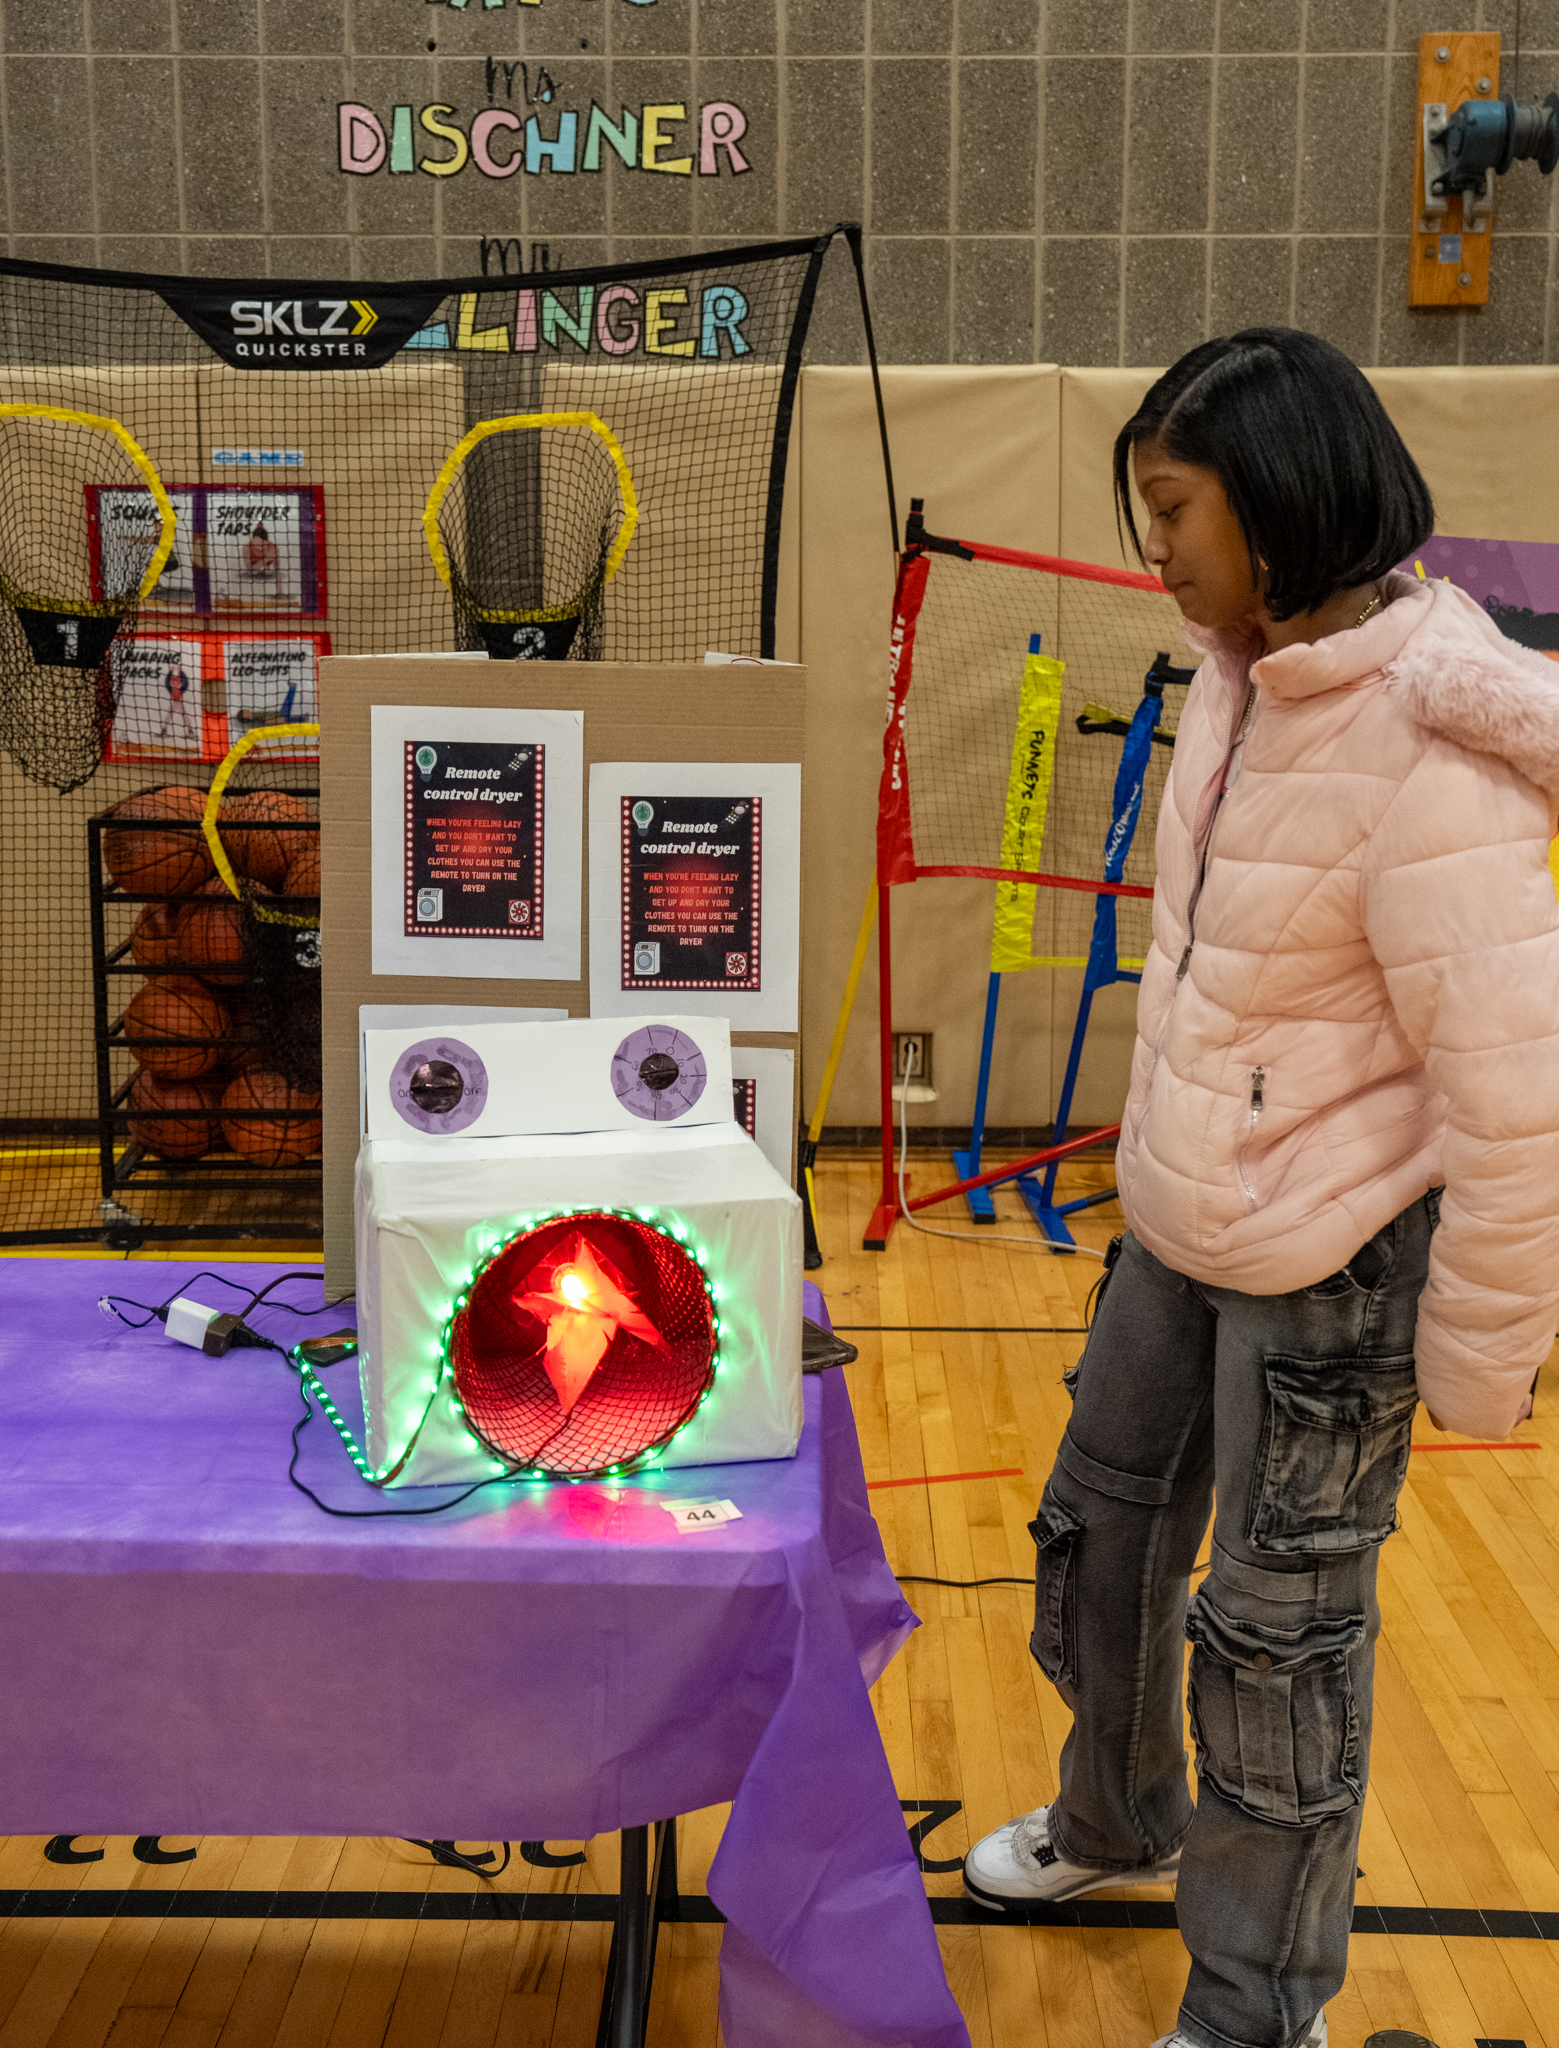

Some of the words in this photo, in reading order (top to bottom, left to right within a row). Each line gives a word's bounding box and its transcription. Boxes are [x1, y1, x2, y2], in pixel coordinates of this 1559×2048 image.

[337, 99, 753, 178] DISCHNER
[230, 300, 349, 336] SKLZ
[236, 343, 367, 357] QUICKSTER
[217, 522, 252, 536] TAPS
[56, 620, 79, 660] 1
[445, 767, 501, 779] Remote
[424, 788, 479, 800] control
[480, 788, 523, 804] dryer
[427, 818, 446, 826] WHEN
[448, 819, 471, 827] YOU'RE
[661, 821, 718, 833] Remote
[449, 832, 461, 840] YOU
[485, 833, 505, 841] WANT
[463, 845, 476, 853] AND
[479, 846, 492, 854] DRY
[495, 846, 512, 854] YOUR
[640, 842, 696, 854] control
[697, 842, 739, 857] dryer
[428, 858, 458, 866] CLOTHES
[460, 858, 473, 866] YOU
[492, 859, 504, 867] USE
[431, 871, 458, 879] REMOTE
[461, 871, 469, 879] TO
[472, 872, 490, 880] TURN
[492, 872, 501, 880] ON
[643, 872, 663, 880] WHEN
[721, 873, 739, 881] LAZY
[463, 884, 485, 892] DRYER
[681, 886, 700, 894] DON'T
[703, 886, 722, 894] WANT
[696, 899, 709, 907] DRY
[712, 899, 730, 907] YOUR
[677, 912, 690, 920] YOU
[693, 912, 706, 920] CAN
[709, 912, 722, 920] USE
[689, 925, 707, 933] TURN
[709, 925, 718, 933] ON
[721, 925, 734, 933] THE
[687, 1510, 716, 1521] 44
